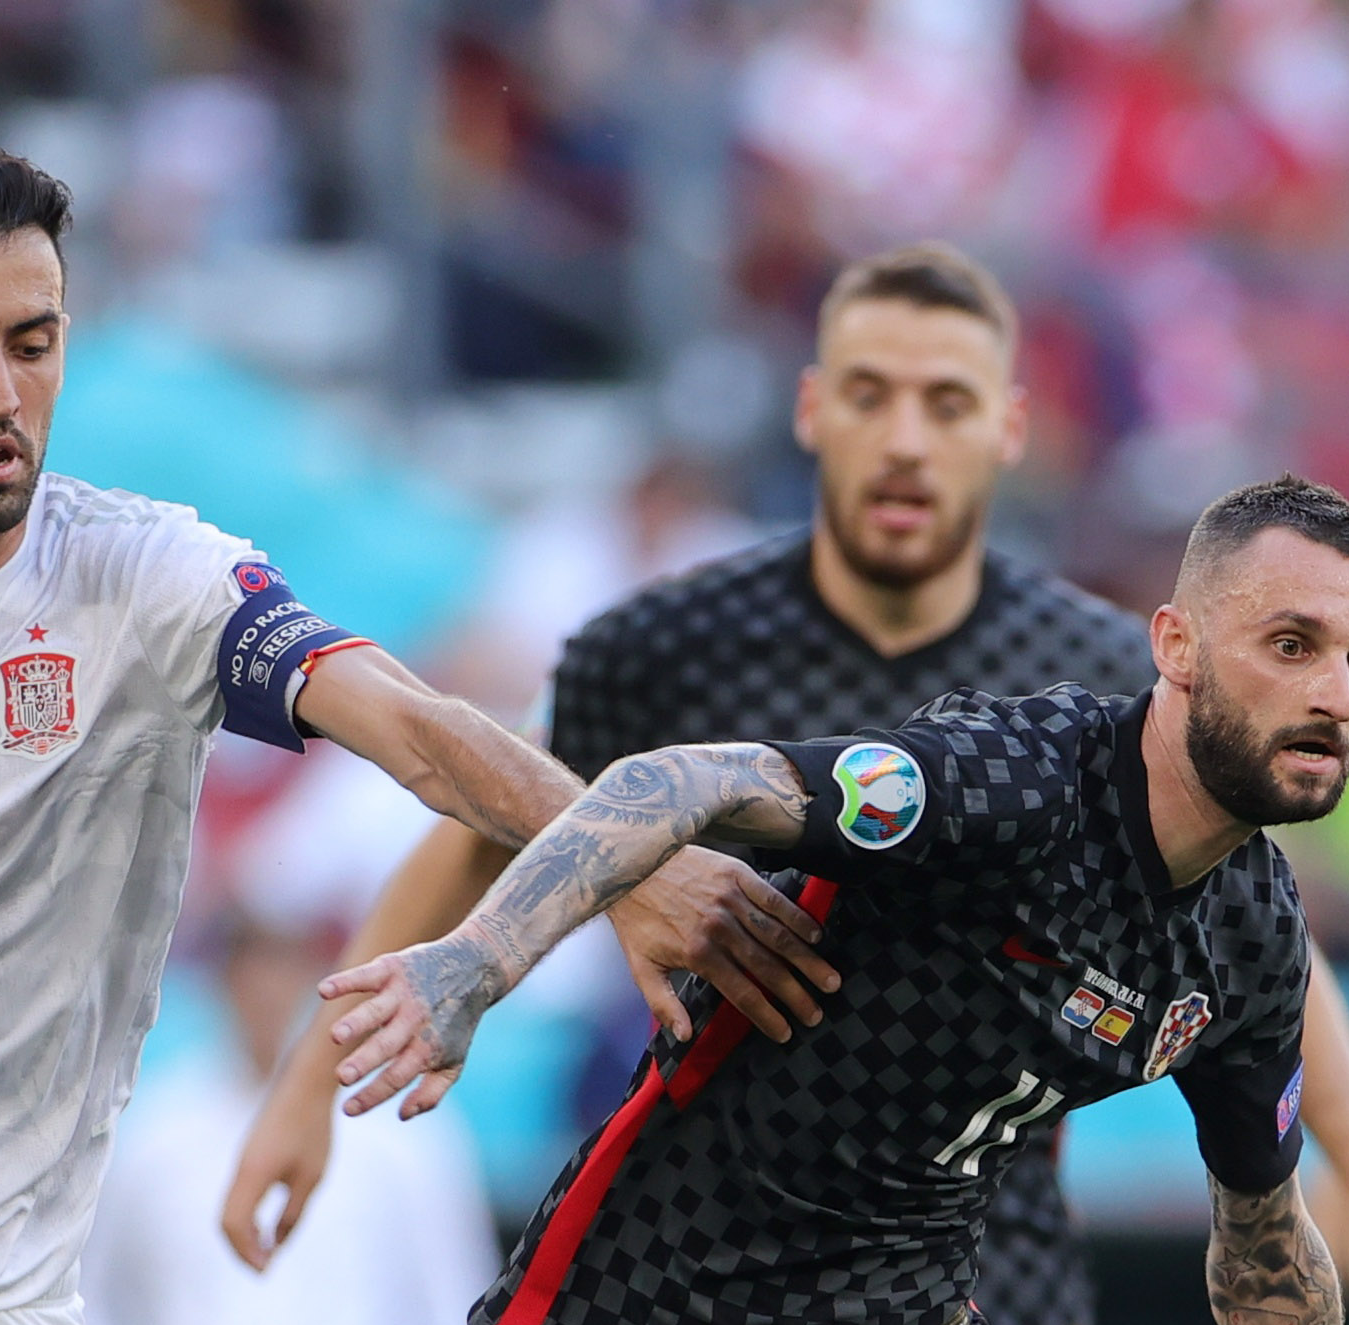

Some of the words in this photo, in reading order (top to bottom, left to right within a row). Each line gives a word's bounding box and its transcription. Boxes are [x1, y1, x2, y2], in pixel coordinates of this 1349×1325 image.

[236, 626, 259, 651] TO
[231, 654, 244, 687] NO
[933, 1069, 1066, 1177] 11
